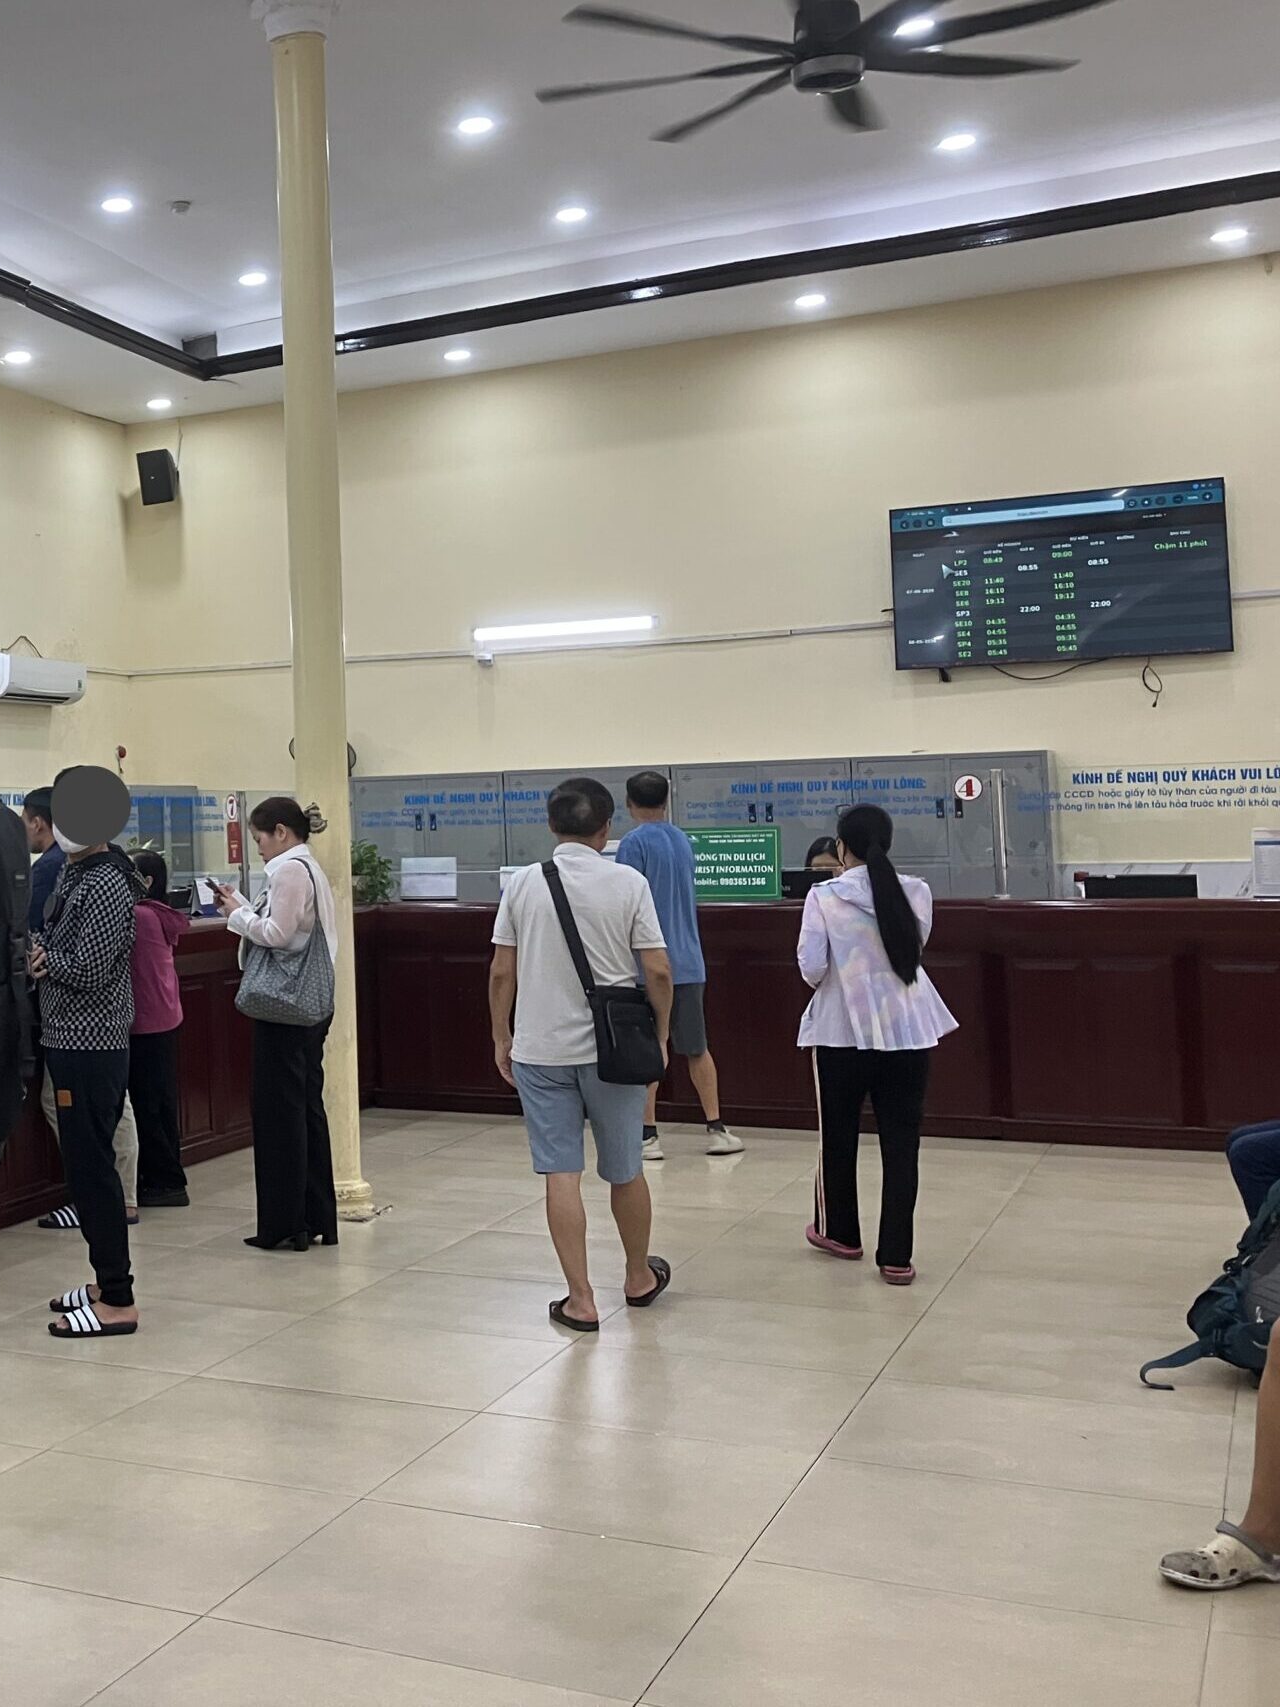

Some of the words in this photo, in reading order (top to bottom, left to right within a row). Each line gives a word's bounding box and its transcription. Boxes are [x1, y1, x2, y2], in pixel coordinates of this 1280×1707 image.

[1019, 605, 1041, 613] 22:00
[1090, 600, 1111, 608] 22:00
[1071, 771, 1103, 785] KÍNH
[1127, 770, 1158, 785] NGHỊ
[1191, 766, 1236, 782] KHÁCH
[1240, 767, 1262, 780] VUI
[958, 778, 974, 797] 4
[228, 798, 234, 816] 7
[719, 852, 732, 861] TIN
[734, 852, 745, 861] DU
[716, 864, 774, 874] INFORMATION
